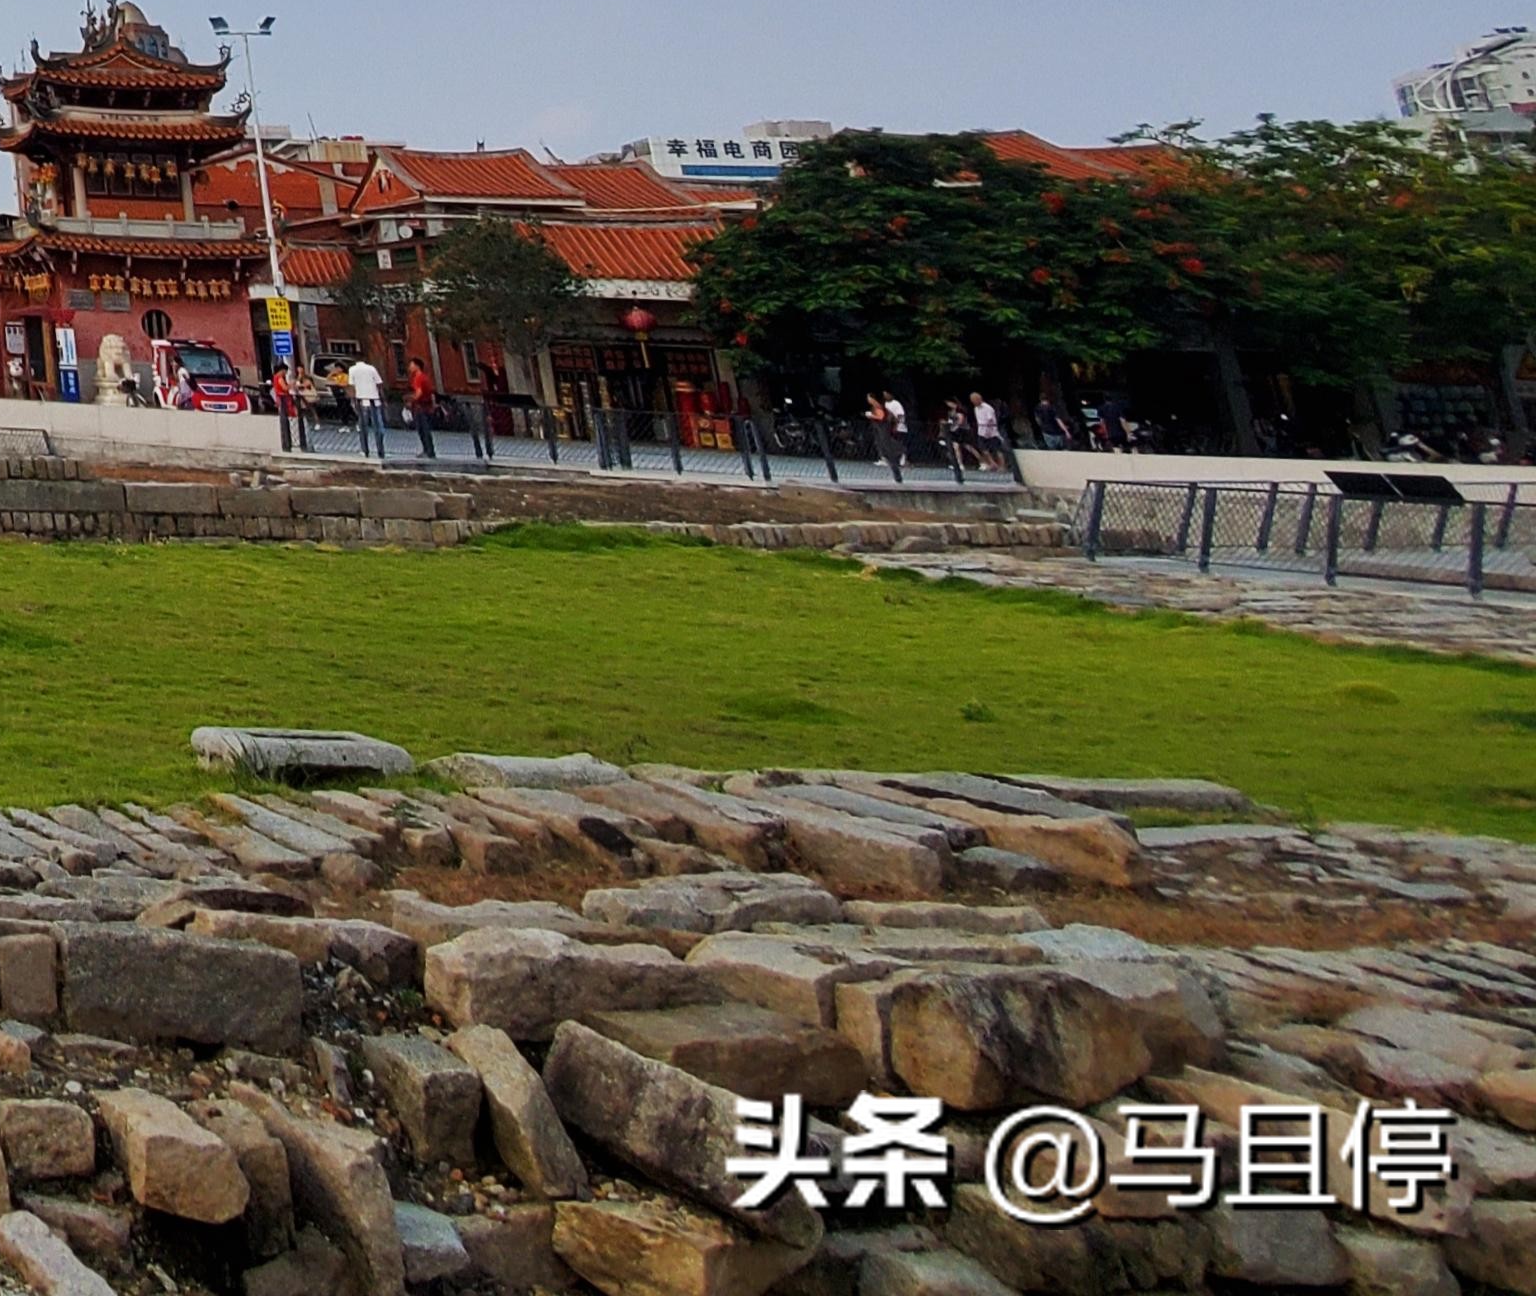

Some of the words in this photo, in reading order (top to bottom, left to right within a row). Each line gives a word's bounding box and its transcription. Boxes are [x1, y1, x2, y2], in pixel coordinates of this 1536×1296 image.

[666, 139, 801, 159] 幸福电商园
